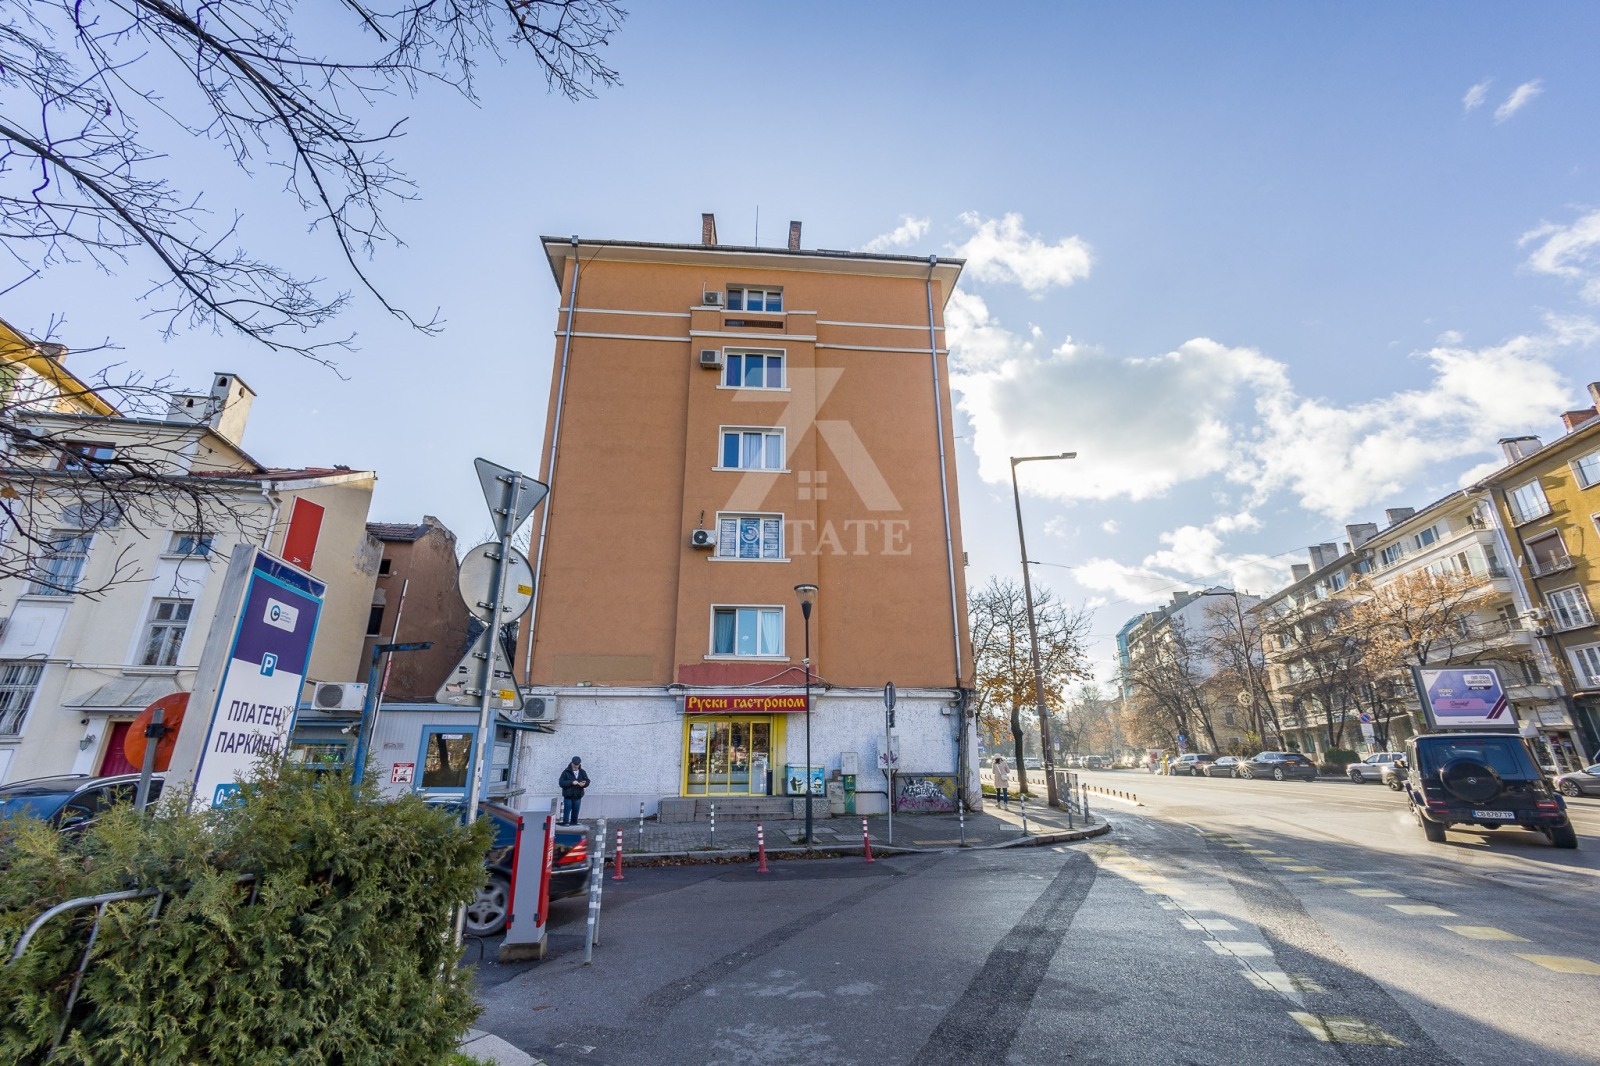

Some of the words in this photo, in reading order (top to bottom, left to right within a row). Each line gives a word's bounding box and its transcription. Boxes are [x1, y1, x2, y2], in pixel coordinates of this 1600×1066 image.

[227, 700, 283, 726] ПЛАТЕН
[688, 696, 728, 712] Руски
[733, 697, 806, 712] гастроном
[214, 731, 280, 755] ПАРКИНГ
